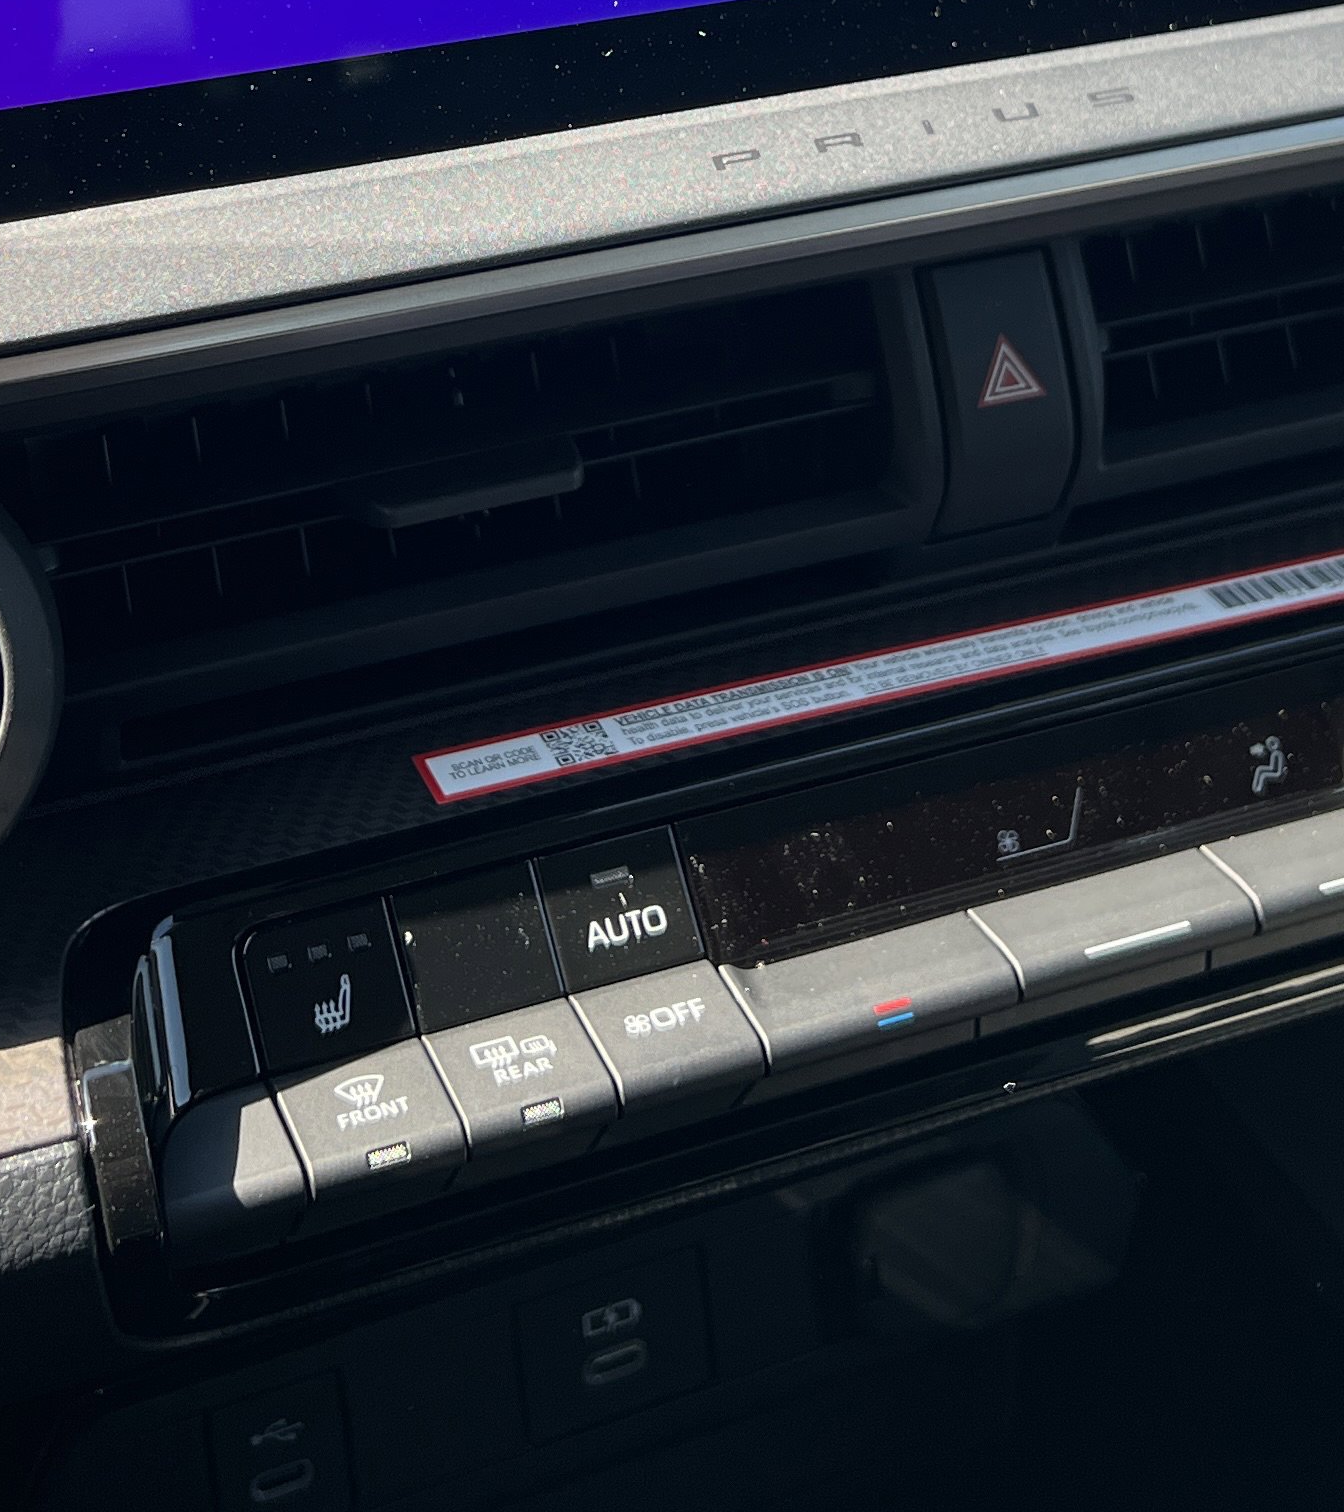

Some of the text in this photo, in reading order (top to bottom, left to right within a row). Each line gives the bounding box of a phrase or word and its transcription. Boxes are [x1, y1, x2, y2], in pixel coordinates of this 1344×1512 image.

[712, 86, 1135, 171] PRIUS
[613, 706, 672, 725] VEHICLE
[673, 697, 711, 712] DATA
[450, 770, 467, 780] TO
[467, 761, 506, 776] LEARN
[451, 758, 484, 772] SCAN
[588, 904, 668, 953] AUTO
[651, 997, 707, 1032] OFF
[493, 1057, 554, 1085] REAR
[336, 1095, 410, 1130] FRONT
